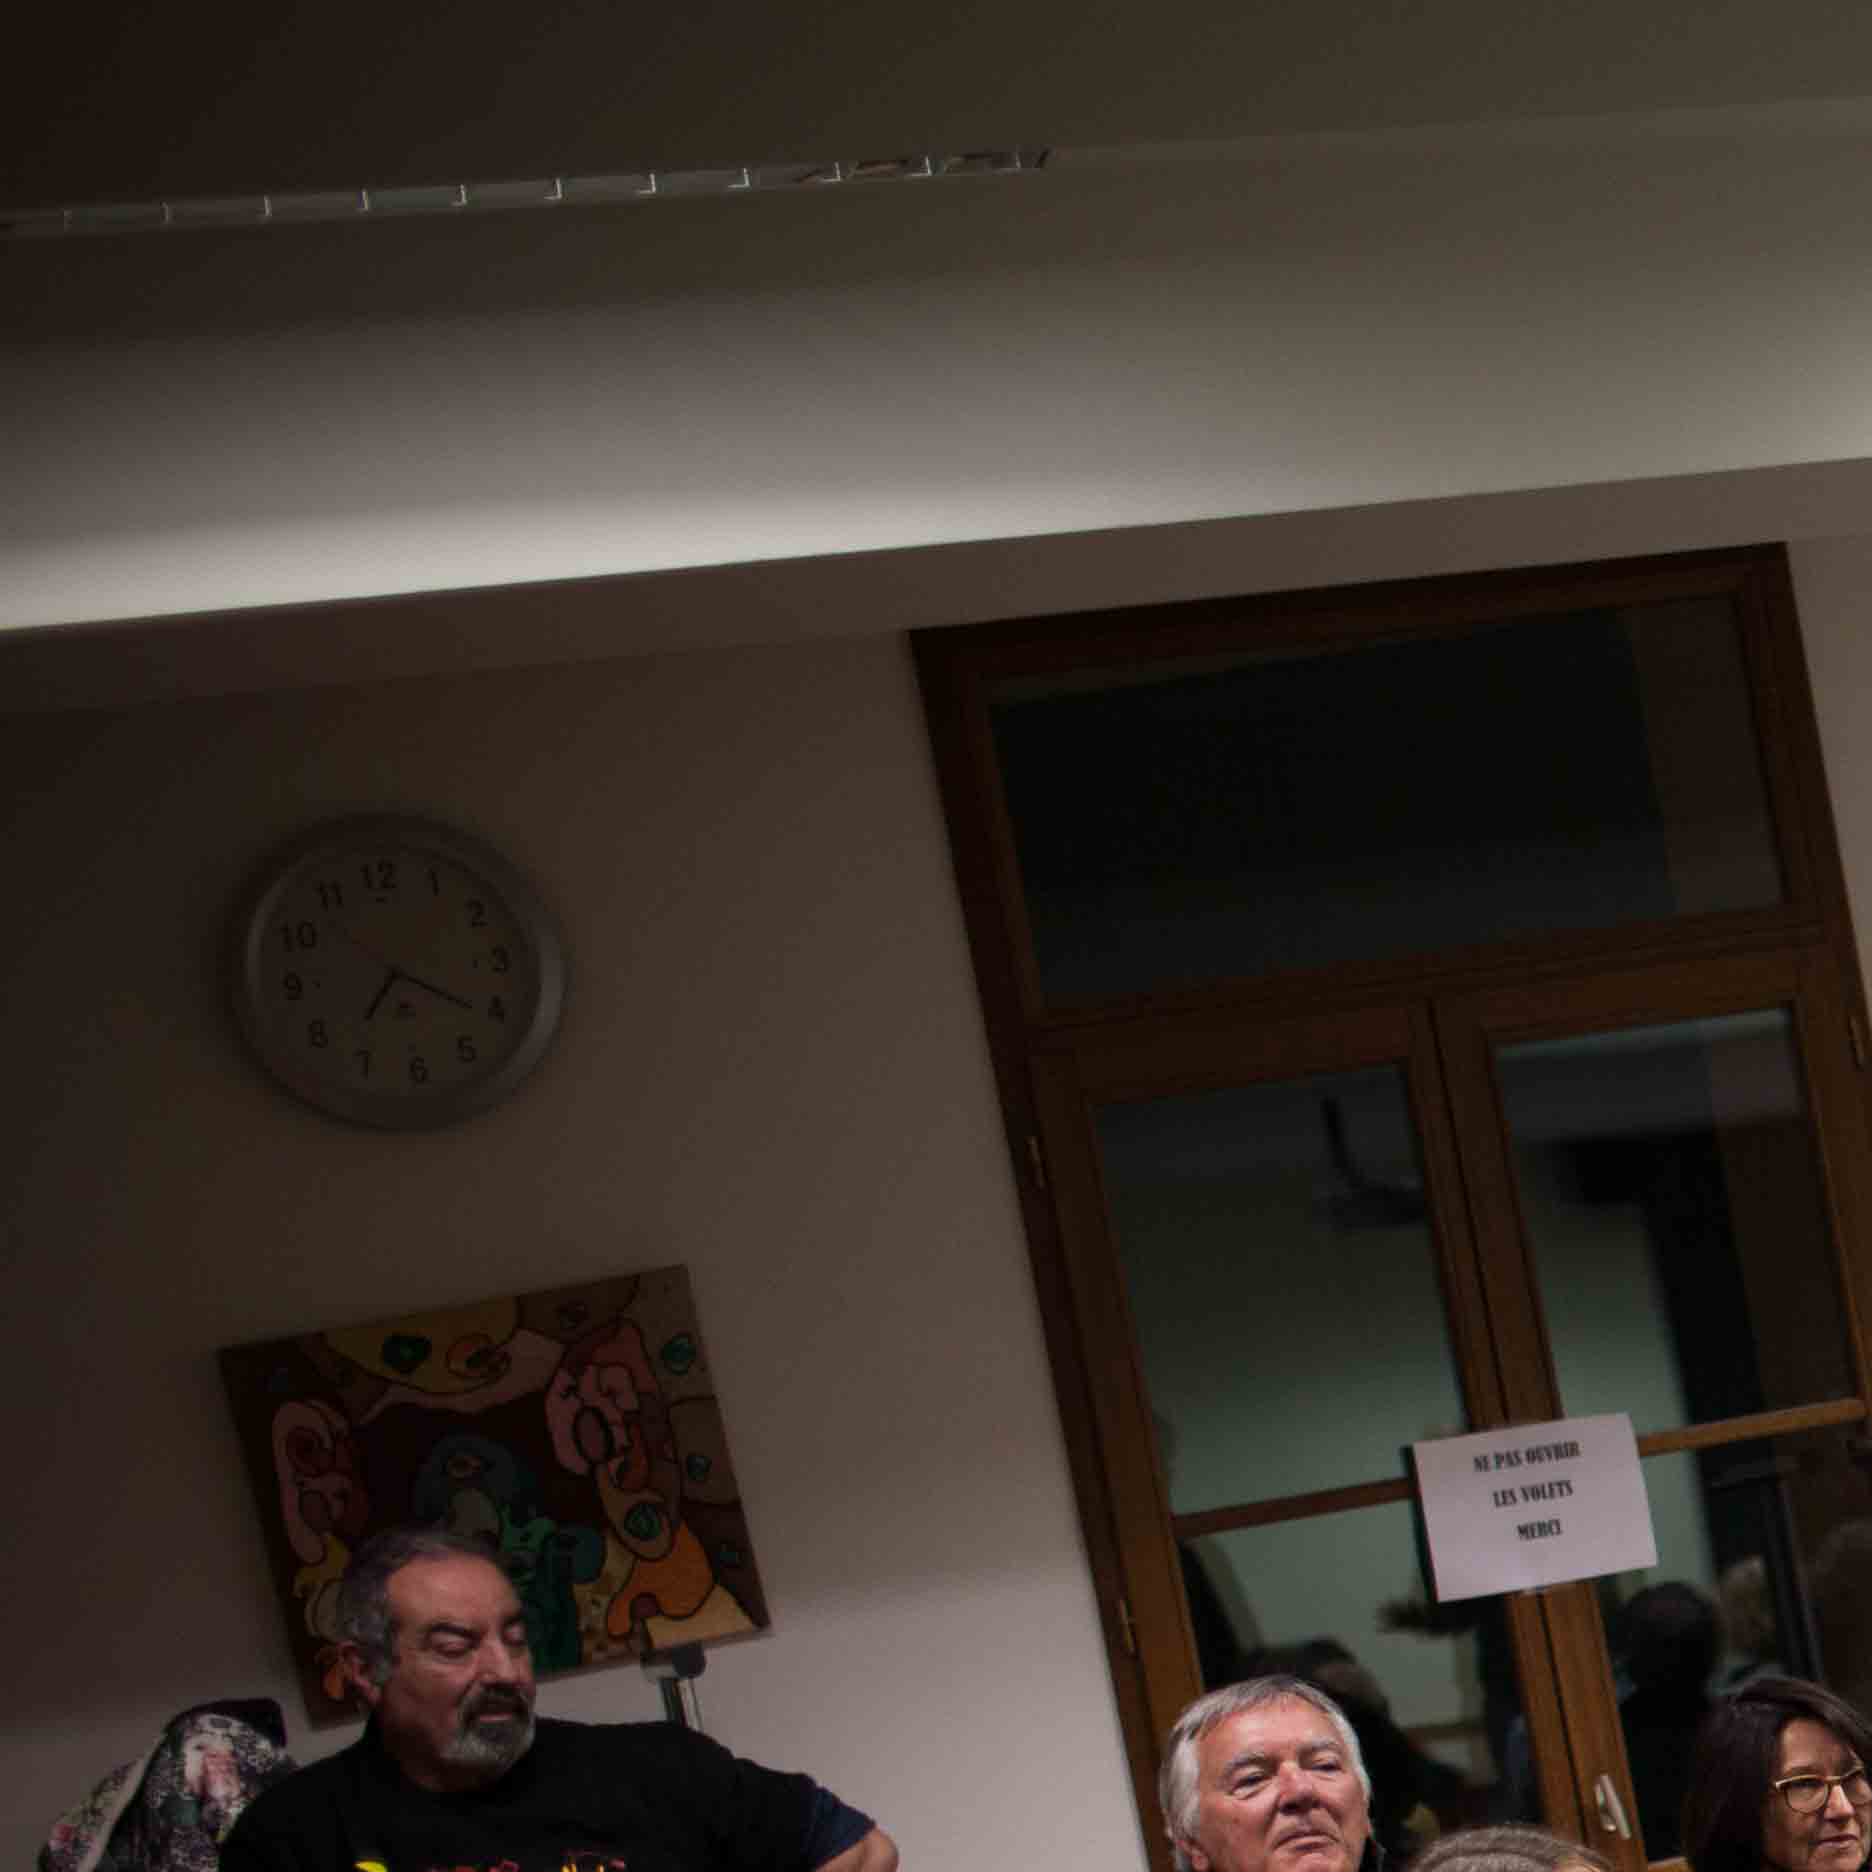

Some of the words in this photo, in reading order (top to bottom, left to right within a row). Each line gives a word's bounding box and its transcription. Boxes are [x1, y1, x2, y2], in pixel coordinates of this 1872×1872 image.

[360, 860, 396, 889] 12
[316, 881, 343, 910] 11
[466, 900, 487, 927] 2
[281, 922, 319, 951] 10
[490, 947, 510, 973] 3
[283, 973, 303, 1001] 9
[486, 995, 506, 1023] 4
[308, 1018, 329, 1049] 8
[354, 1048, 372, 1077] 7
[457, 1035, 477, 1062] 5
[409, 1057, 429, 1084] 6
[1473, 1455, 1491, 1472] NE
[1494, 1449, 1522, 1470] PAS
[1525, 1440, 1580, 1464] OUVRIR
[1492, 1487, 1518, 1507] LES
[1520, 1480, 1574, 1503] VOLETS
[1516, 1518, 1562, 1540] MERCI
